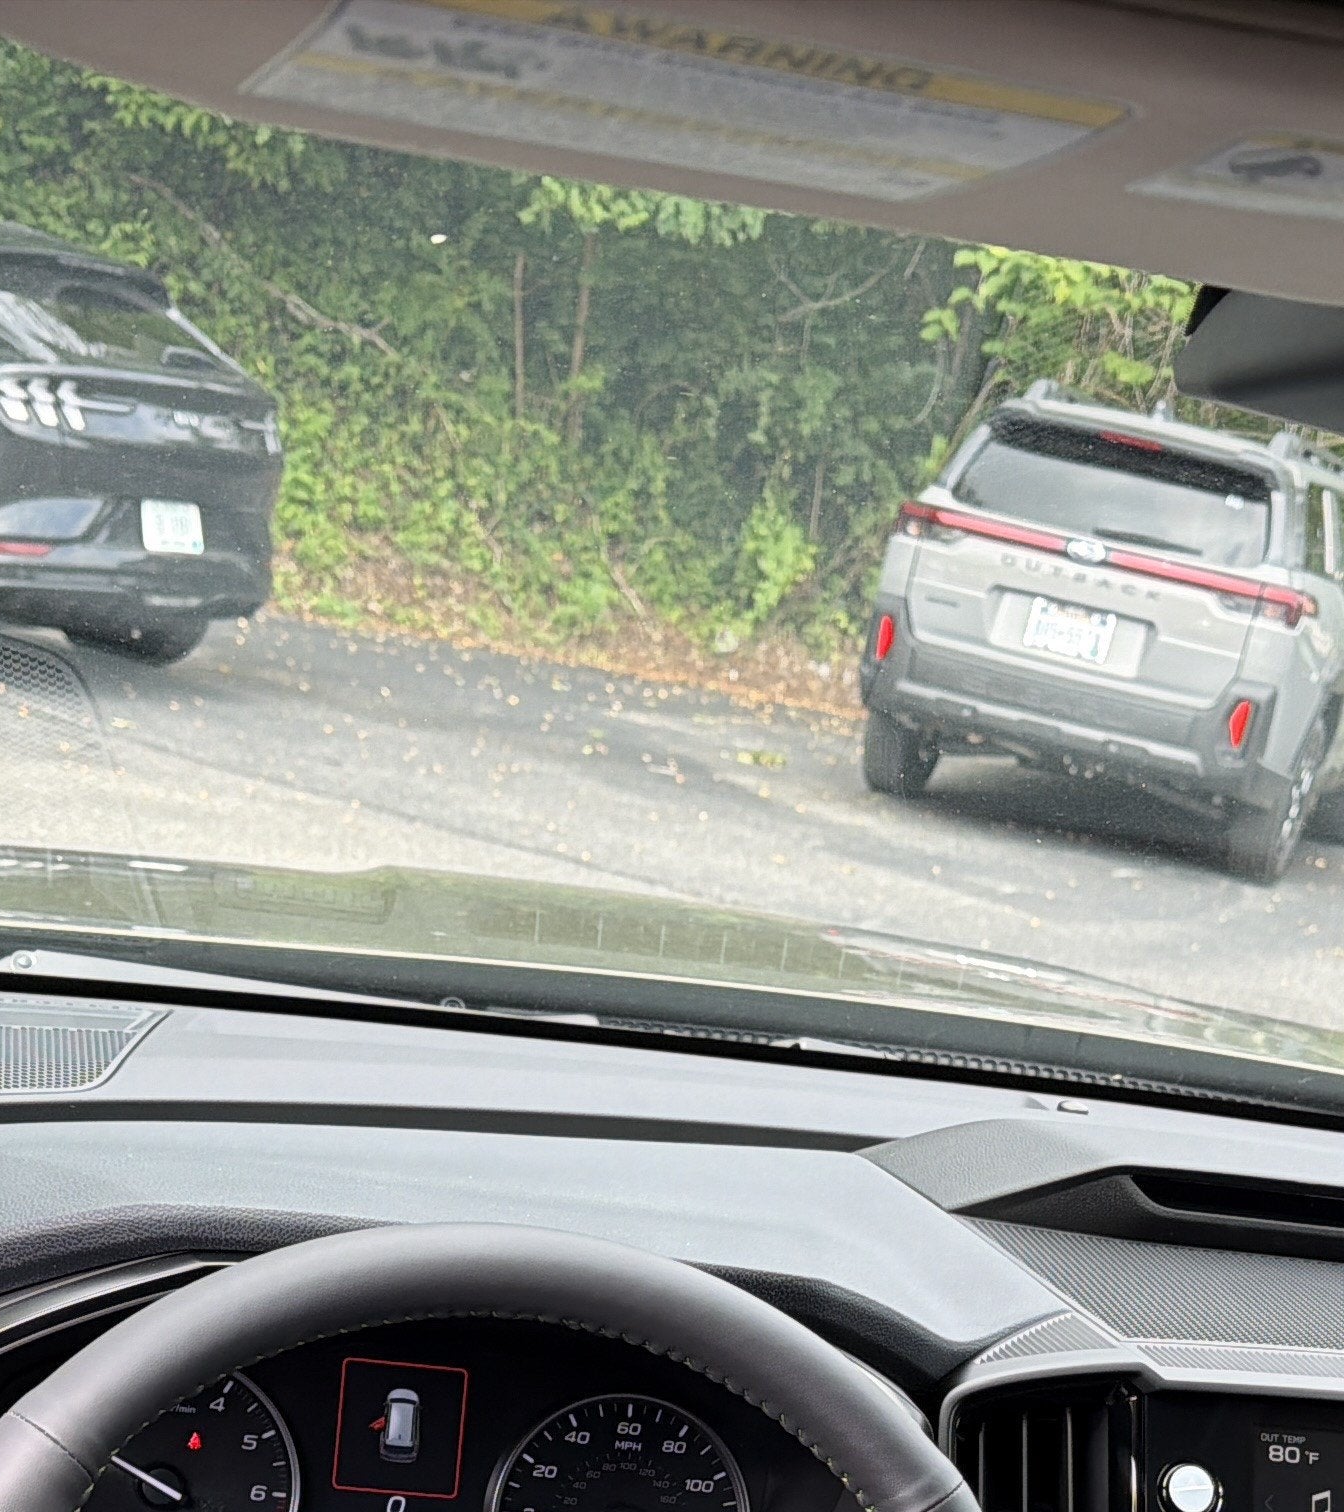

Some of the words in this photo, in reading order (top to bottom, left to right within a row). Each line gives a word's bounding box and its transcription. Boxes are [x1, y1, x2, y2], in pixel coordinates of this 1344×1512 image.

[614, 14, 934, 90] WARNING
[209, 1397, 225, 1412] 4
[617, 1422, 642, 1436] 60
[242, 1435, 258, 1450] 5
[565, 1431, 590, 1444] 40
[1260, 1432, 1280, 1443] OUT
[1282, 1434, 1306, 1445] TEMP
[615, 1441, 642, 1451] MPH
[662, 1441, 686, 1454] 80
[1268, 1445, 1300, 1464] 80
[532, 1465, 557, 1479] 20
[620, 1463, 637, 1471] 100
[639, 1468, 655, 1477] 120
[250, 1485, 267, 1500] 6
[685, 1479, 714, 1493] 100
